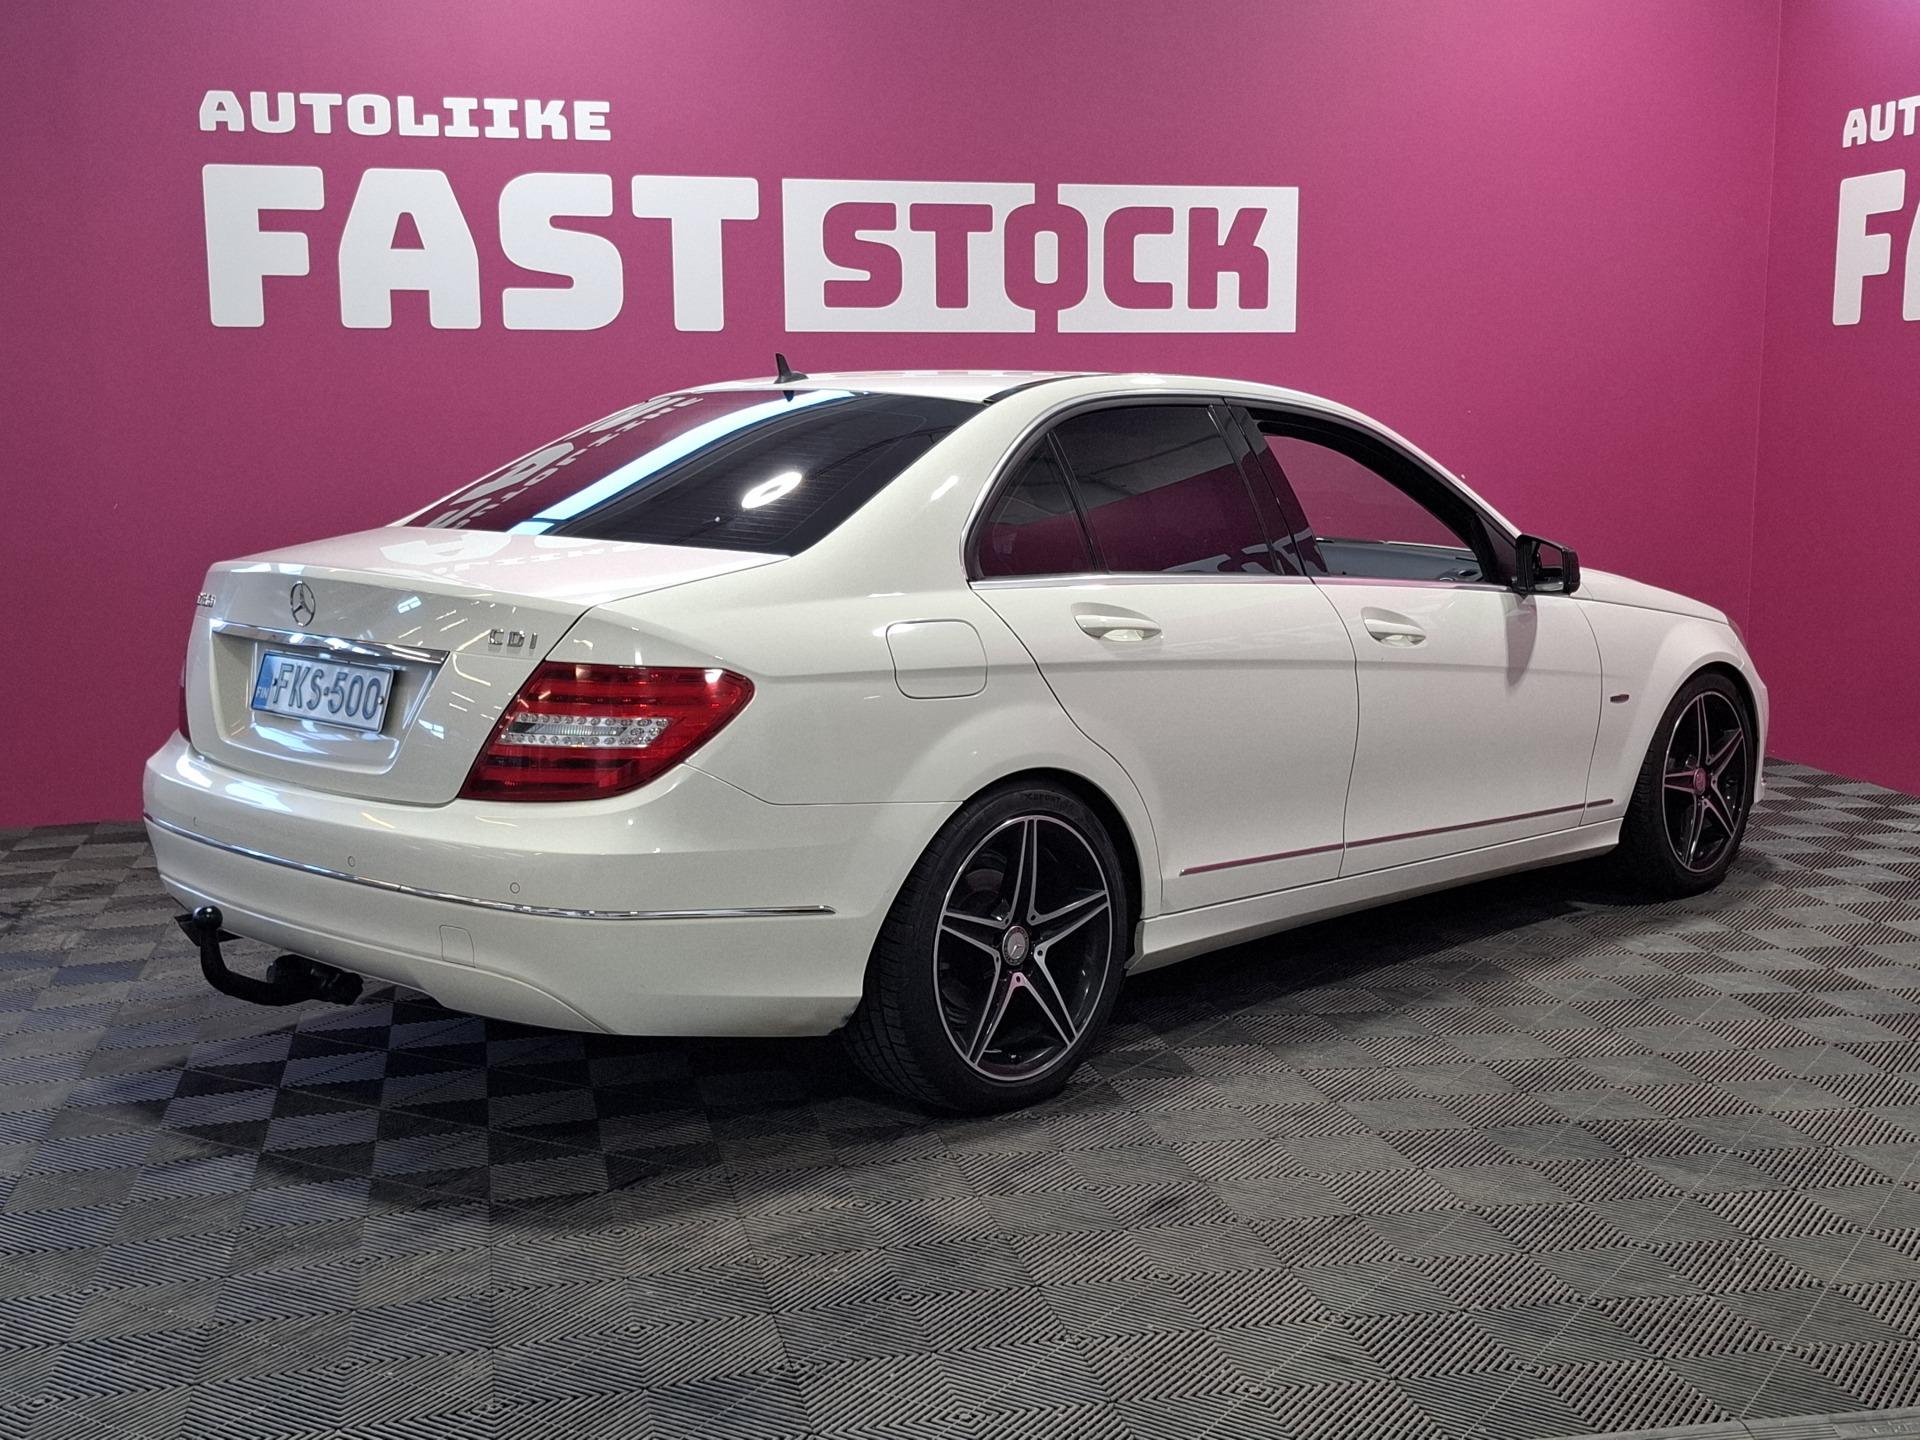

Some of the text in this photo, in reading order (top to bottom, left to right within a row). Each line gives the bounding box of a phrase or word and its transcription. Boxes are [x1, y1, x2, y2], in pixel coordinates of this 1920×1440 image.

[199, 90, 611, 141] AUTOLIIKE
[1832, 168, 1920, 326] F
[488, 629, 538, 650] CDI
[272, 662, 382, 720] FKS-500
